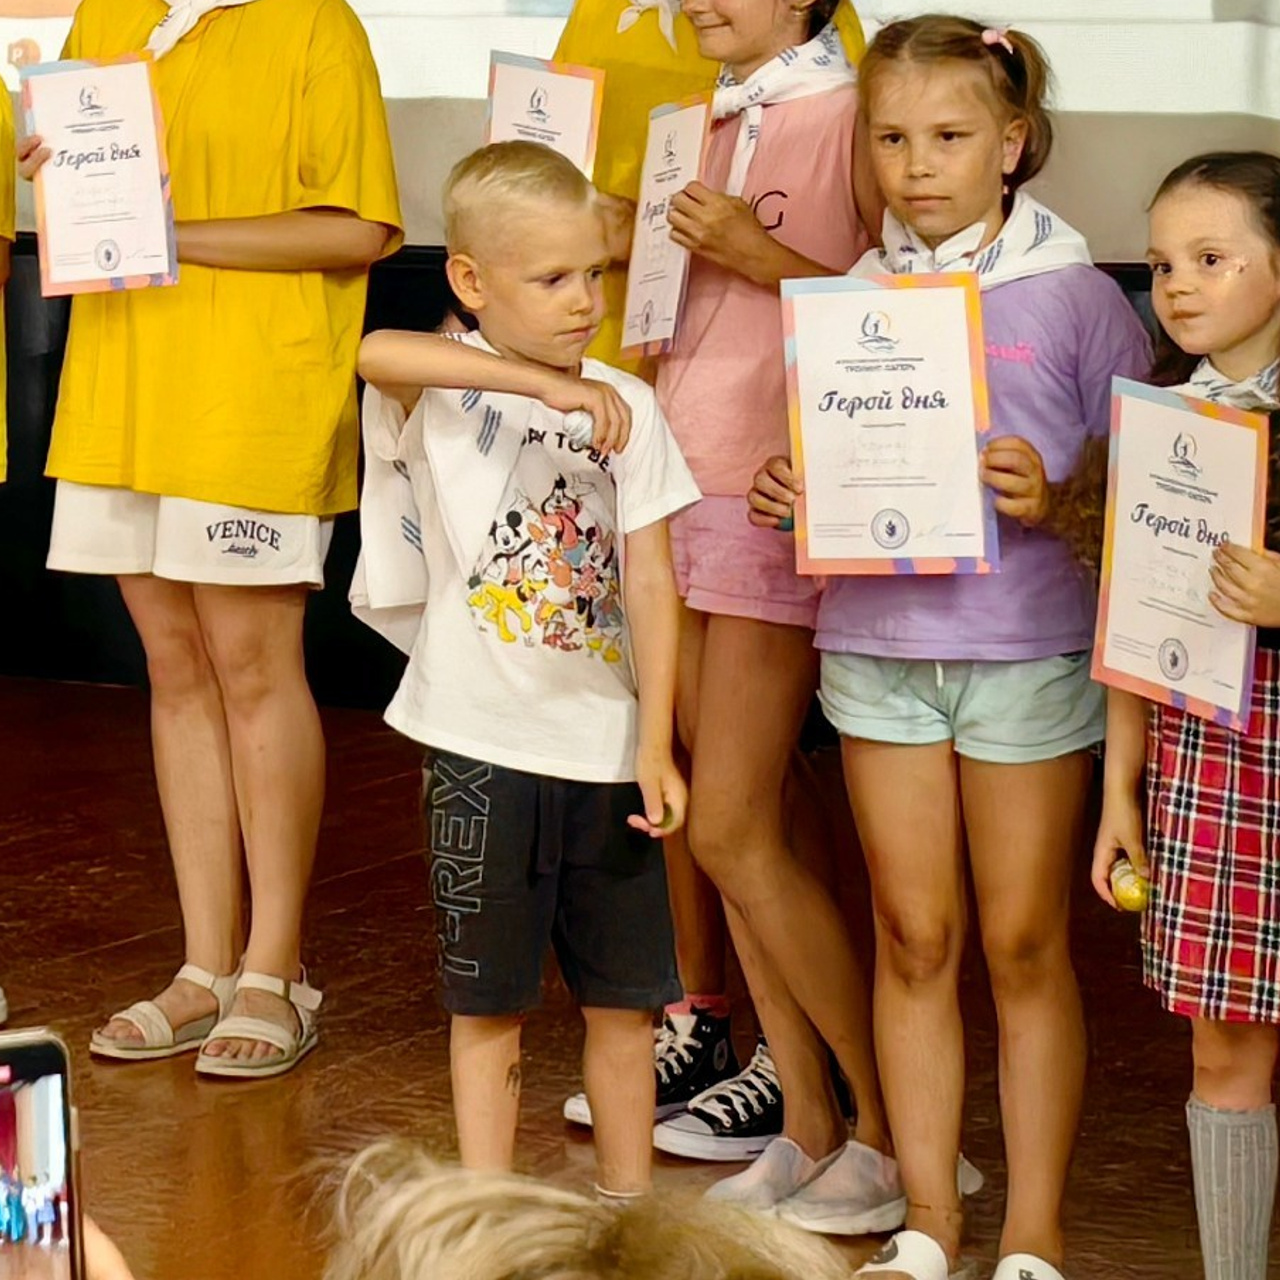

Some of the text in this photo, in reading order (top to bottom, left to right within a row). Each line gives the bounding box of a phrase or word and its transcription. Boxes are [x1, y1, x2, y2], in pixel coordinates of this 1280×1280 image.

[54, 149, 105, 170] Герой
[818, 386, 949, 418] Герой дня
[206, 519, 282, 551] VENICE
[1131, 503, 1191, 539] Герой
[431, 759, 493, 979] T-REX
